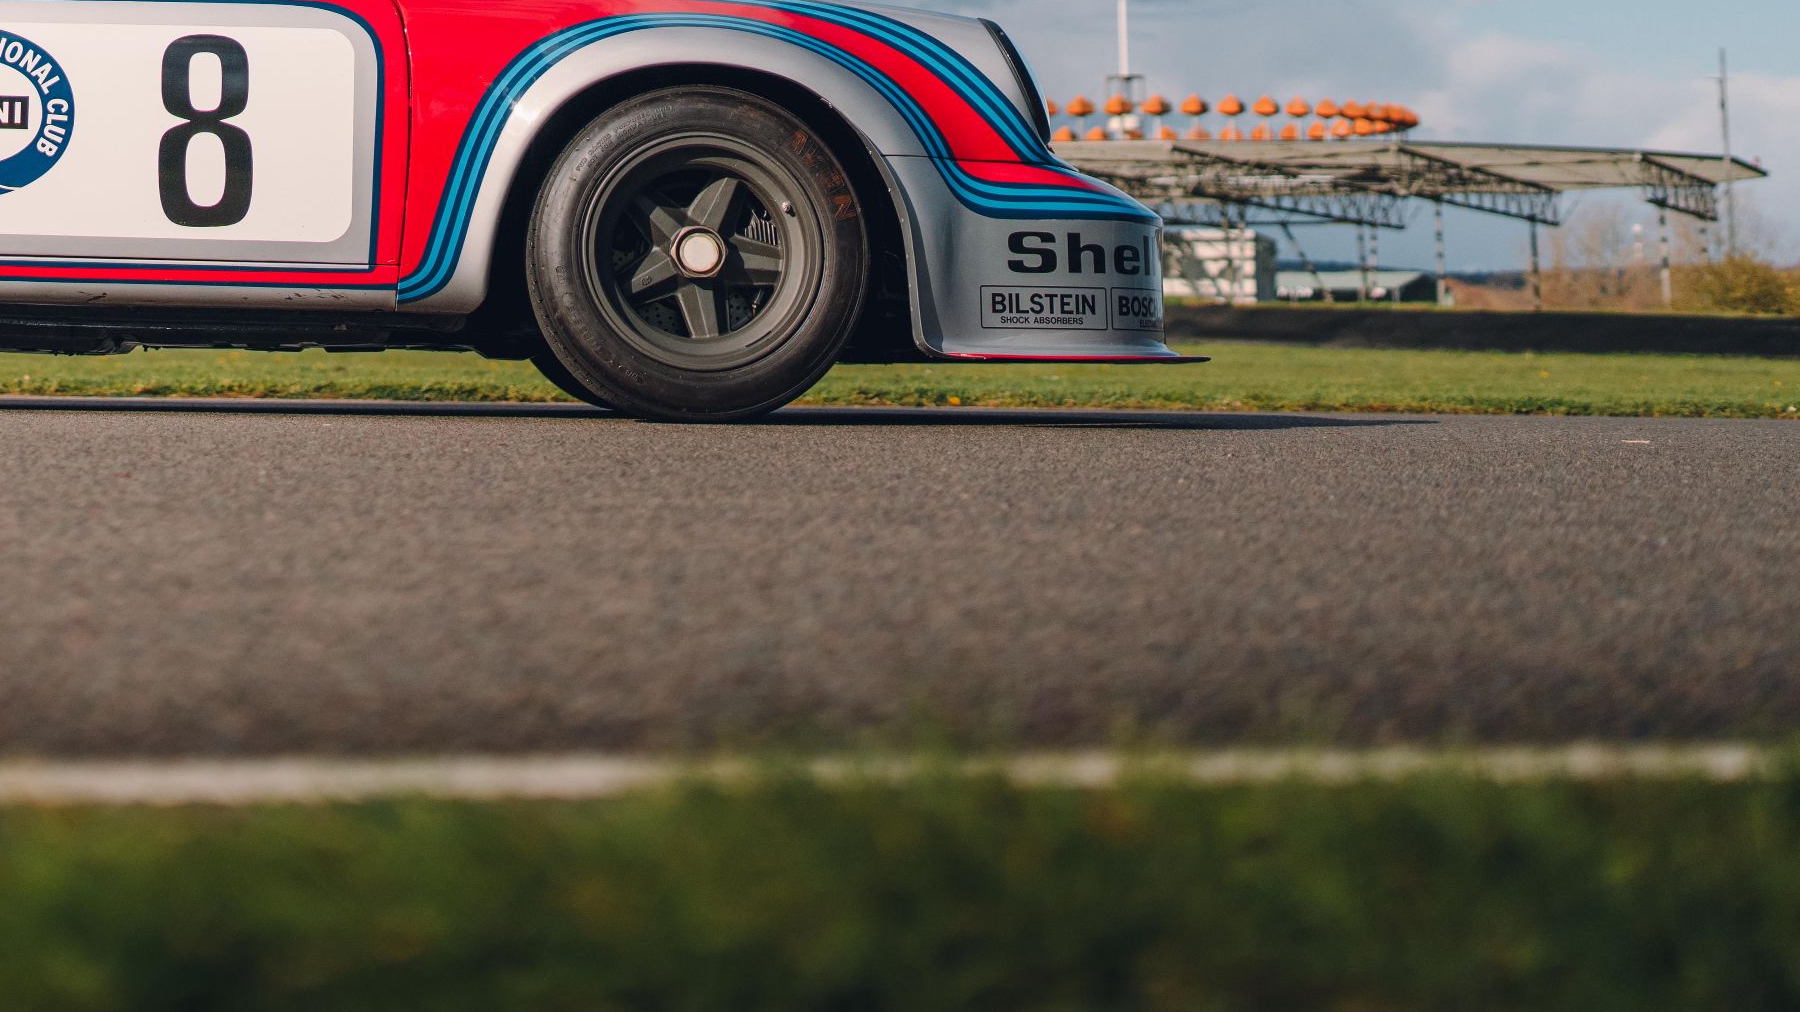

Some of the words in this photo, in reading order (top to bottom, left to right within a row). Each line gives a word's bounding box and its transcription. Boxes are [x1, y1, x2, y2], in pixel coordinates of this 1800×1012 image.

[36, 98, 69, 158] CLUB
[158, 33, 253, 227] 8
[991, 293, 1096, 315] BILSTEIN
[1000, 316, 1030, 324] SHOCK
[1033, 317, 1084, 325] ABSORBERS
